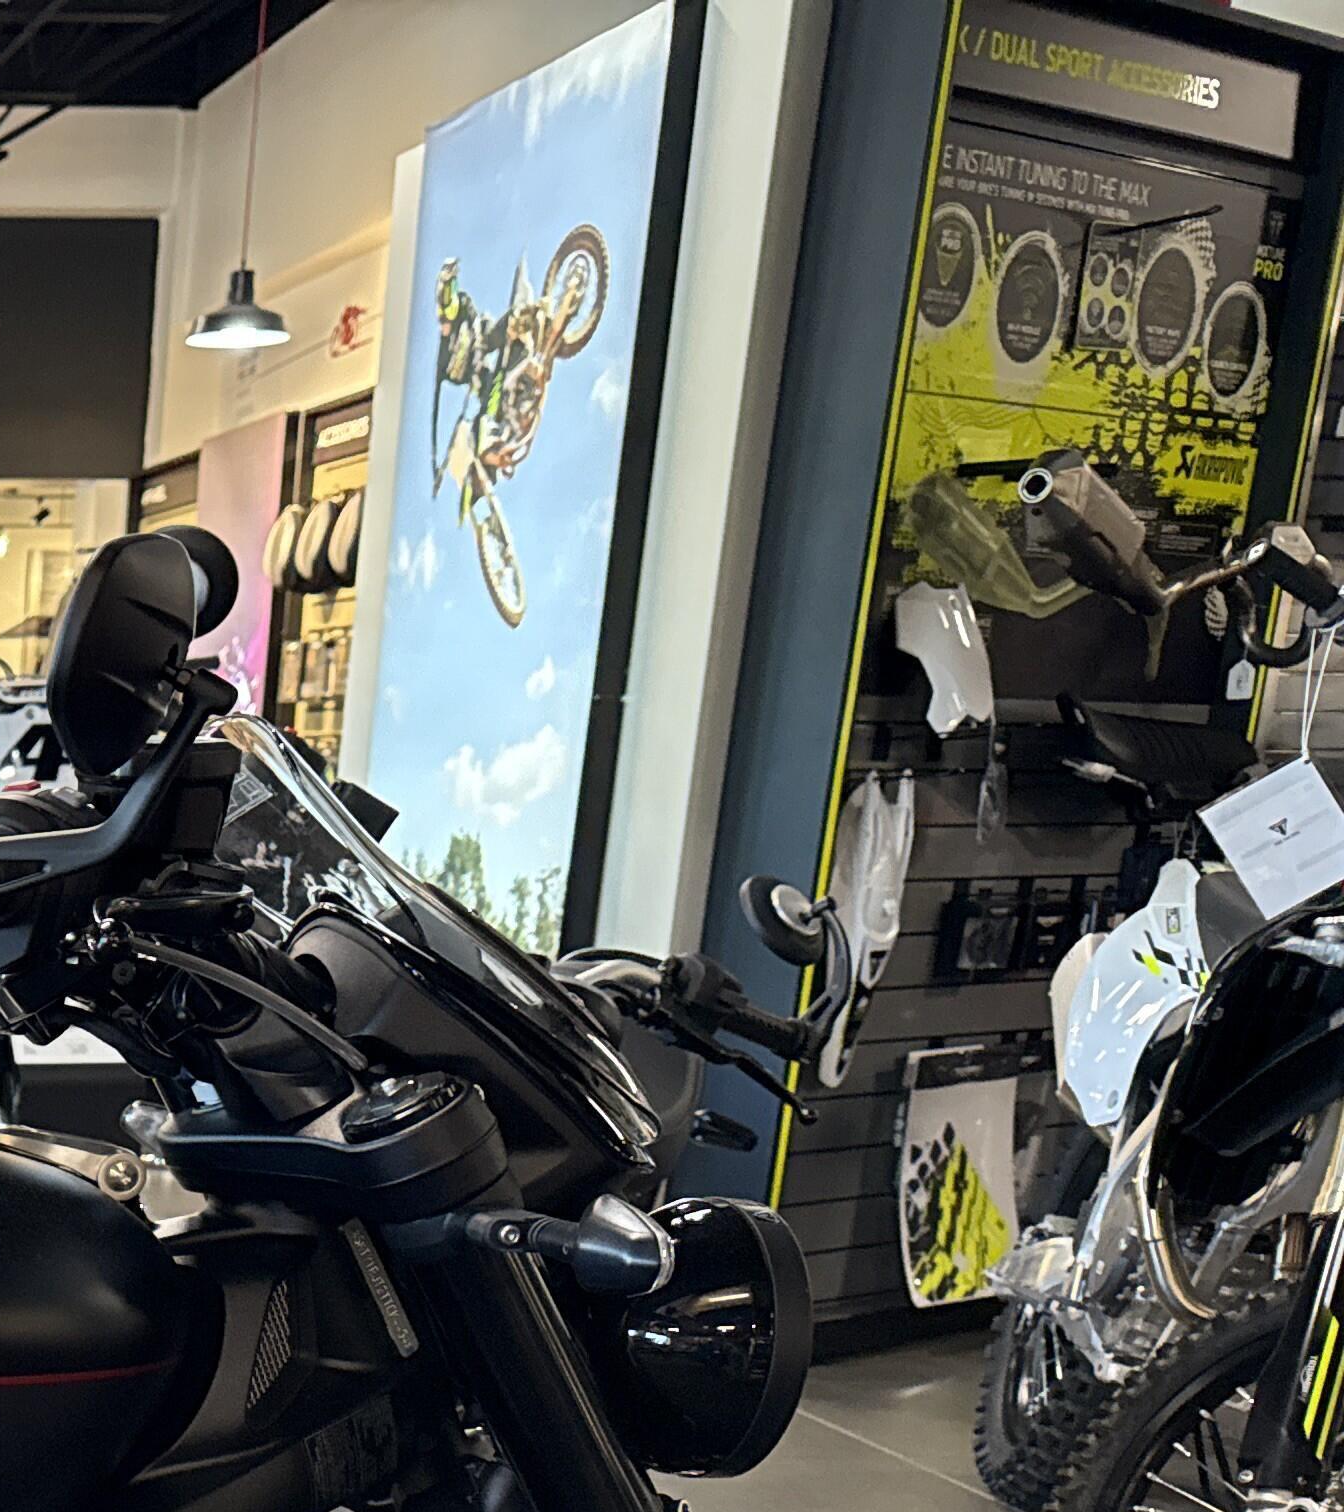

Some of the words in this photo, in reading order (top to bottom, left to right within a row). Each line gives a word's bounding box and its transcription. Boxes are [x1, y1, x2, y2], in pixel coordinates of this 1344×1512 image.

[990, 31, 1041, 69] DUAL
[1045, 42, 1105, 81] SPORT
[1106, 58, 1220, 109] ACCESSORIES
[955, 146, 1015, 180] INSTANT
[1017, 158, 1068, 191] TUNING
[1070, 169, 1089, 196] TO
[1091, 173, 1118, 201] THE
[1119, 180, 1153, 208] MAX
[1253, 257, 1284, 281] PRO
